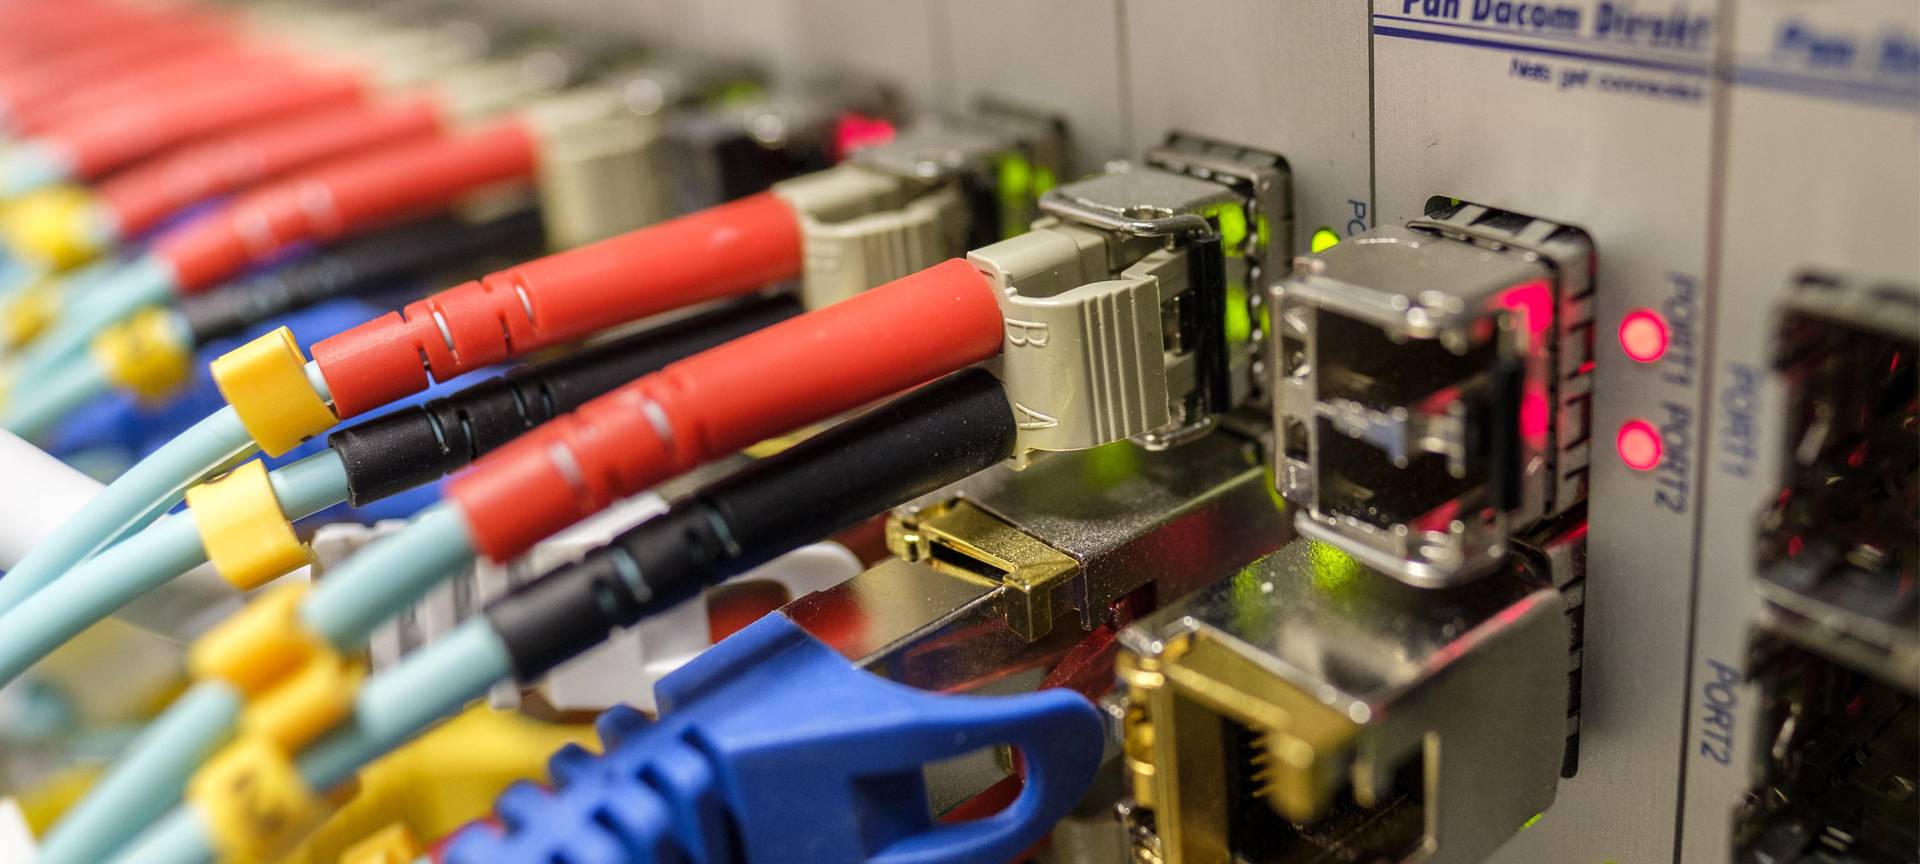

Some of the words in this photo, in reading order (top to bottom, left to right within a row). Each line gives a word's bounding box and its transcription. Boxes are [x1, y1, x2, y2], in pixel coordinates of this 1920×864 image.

[1472, 0, 1580, 30] Dacom
[1005, 317, 1049, 347] B
[1015, 401, 1059, 430] A
[1655, 401, 1692, 515] PORT2
[1701, 658, 1738, 766] PORT2
